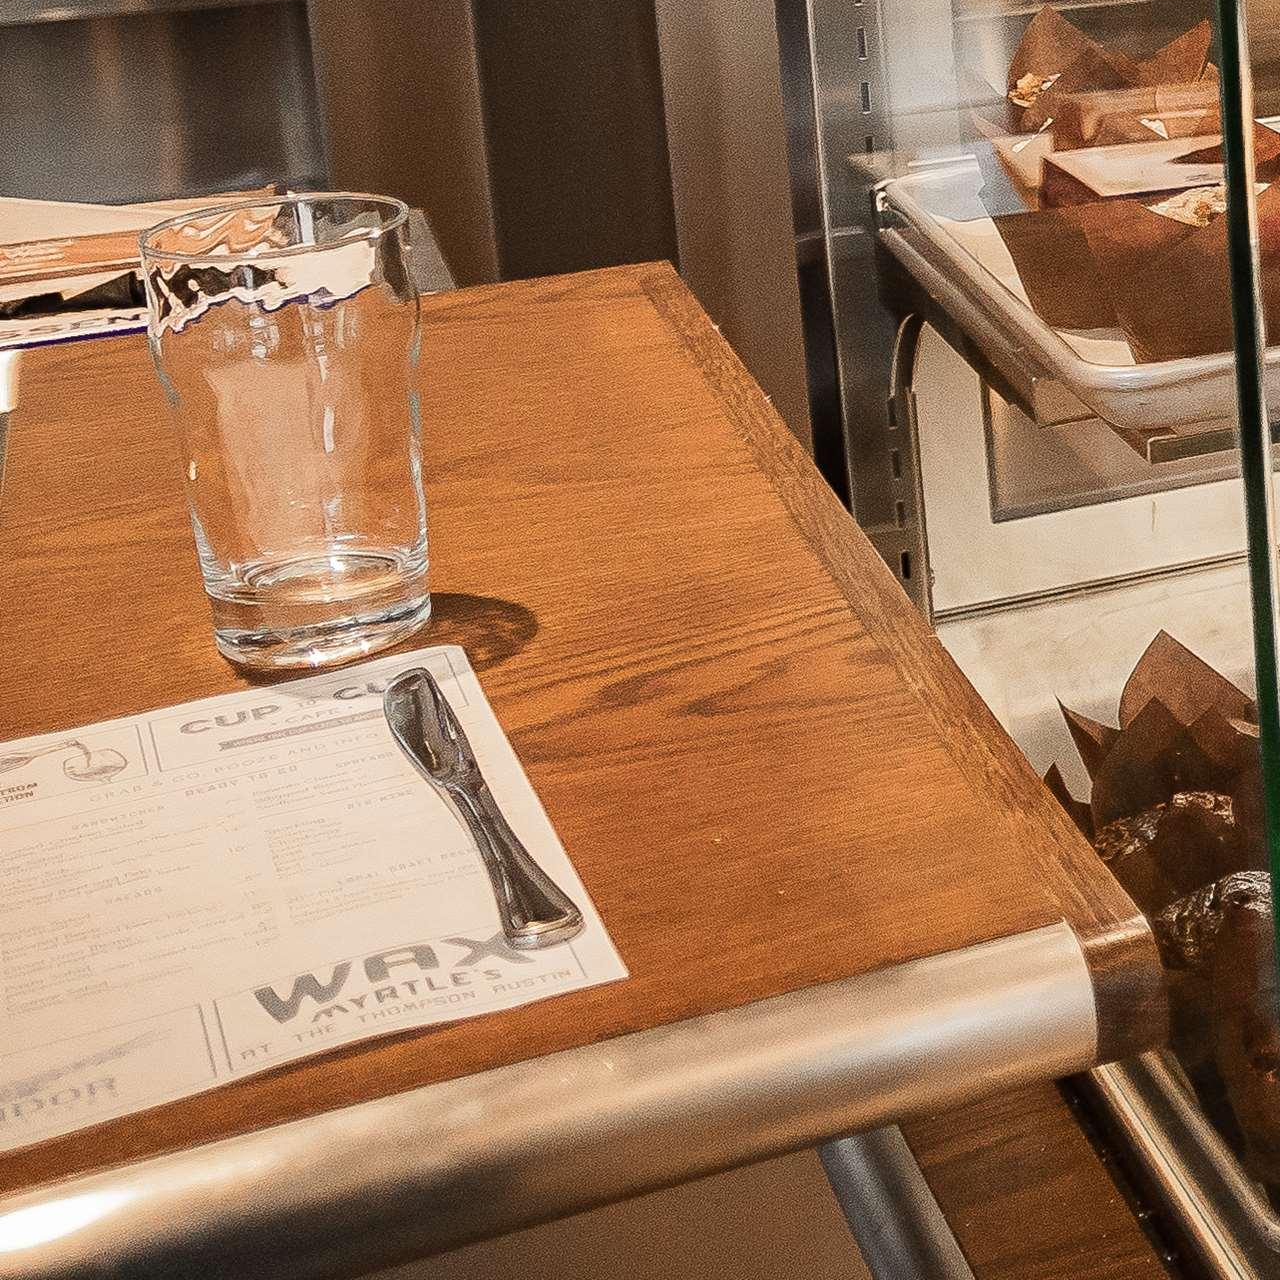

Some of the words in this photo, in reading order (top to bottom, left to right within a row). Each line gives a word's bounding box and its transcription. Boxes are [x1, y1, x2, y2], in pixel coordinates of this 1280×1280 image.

[180, 704, 281, 735] CUP
[332, 682, 386, 701] CU
[253, 930, 535, 1024] WAX
